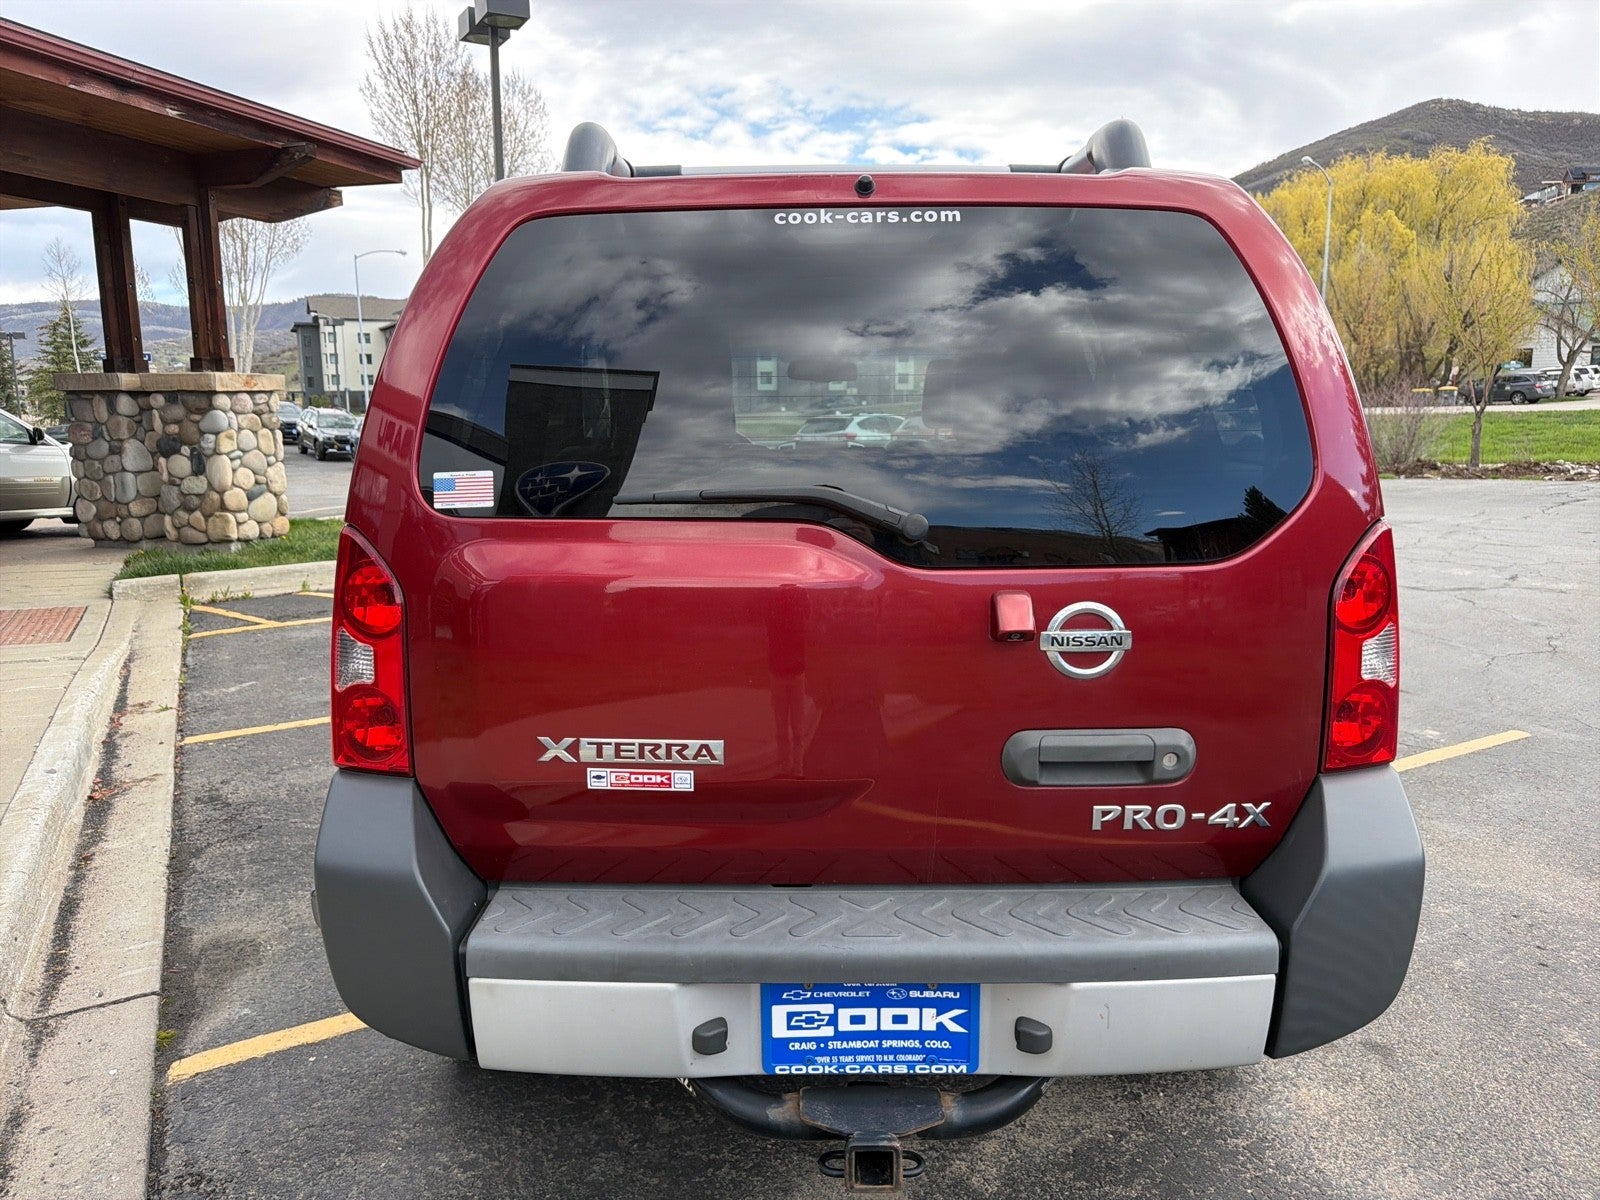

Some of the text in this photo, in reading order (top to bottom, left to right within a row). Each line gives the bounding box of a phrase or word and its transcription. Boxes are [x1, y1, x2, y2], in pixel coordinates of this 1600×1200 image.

[774, 209, 961, 225] cook-cars.com
[1050, 635, 1123, 648] NISSAN
[610, 772, 671, 784] COOK
[1091, 801, 1272, 831] PRO-4X
[813, 990, 871, 998] CHEVROLET
[908, 990, 960, 999] SUBARU
[771, 1003, 969, 1039] COOK
[789, 1039, 952, 1051] CRAIG STEAMBOAT SPRINGS, COLO.
[839, 1055, 855, 1063] YEARS
[875, 1054, 883, 1062] TO
[774, 1064, 967, 1074] COOK-CARS.COM
